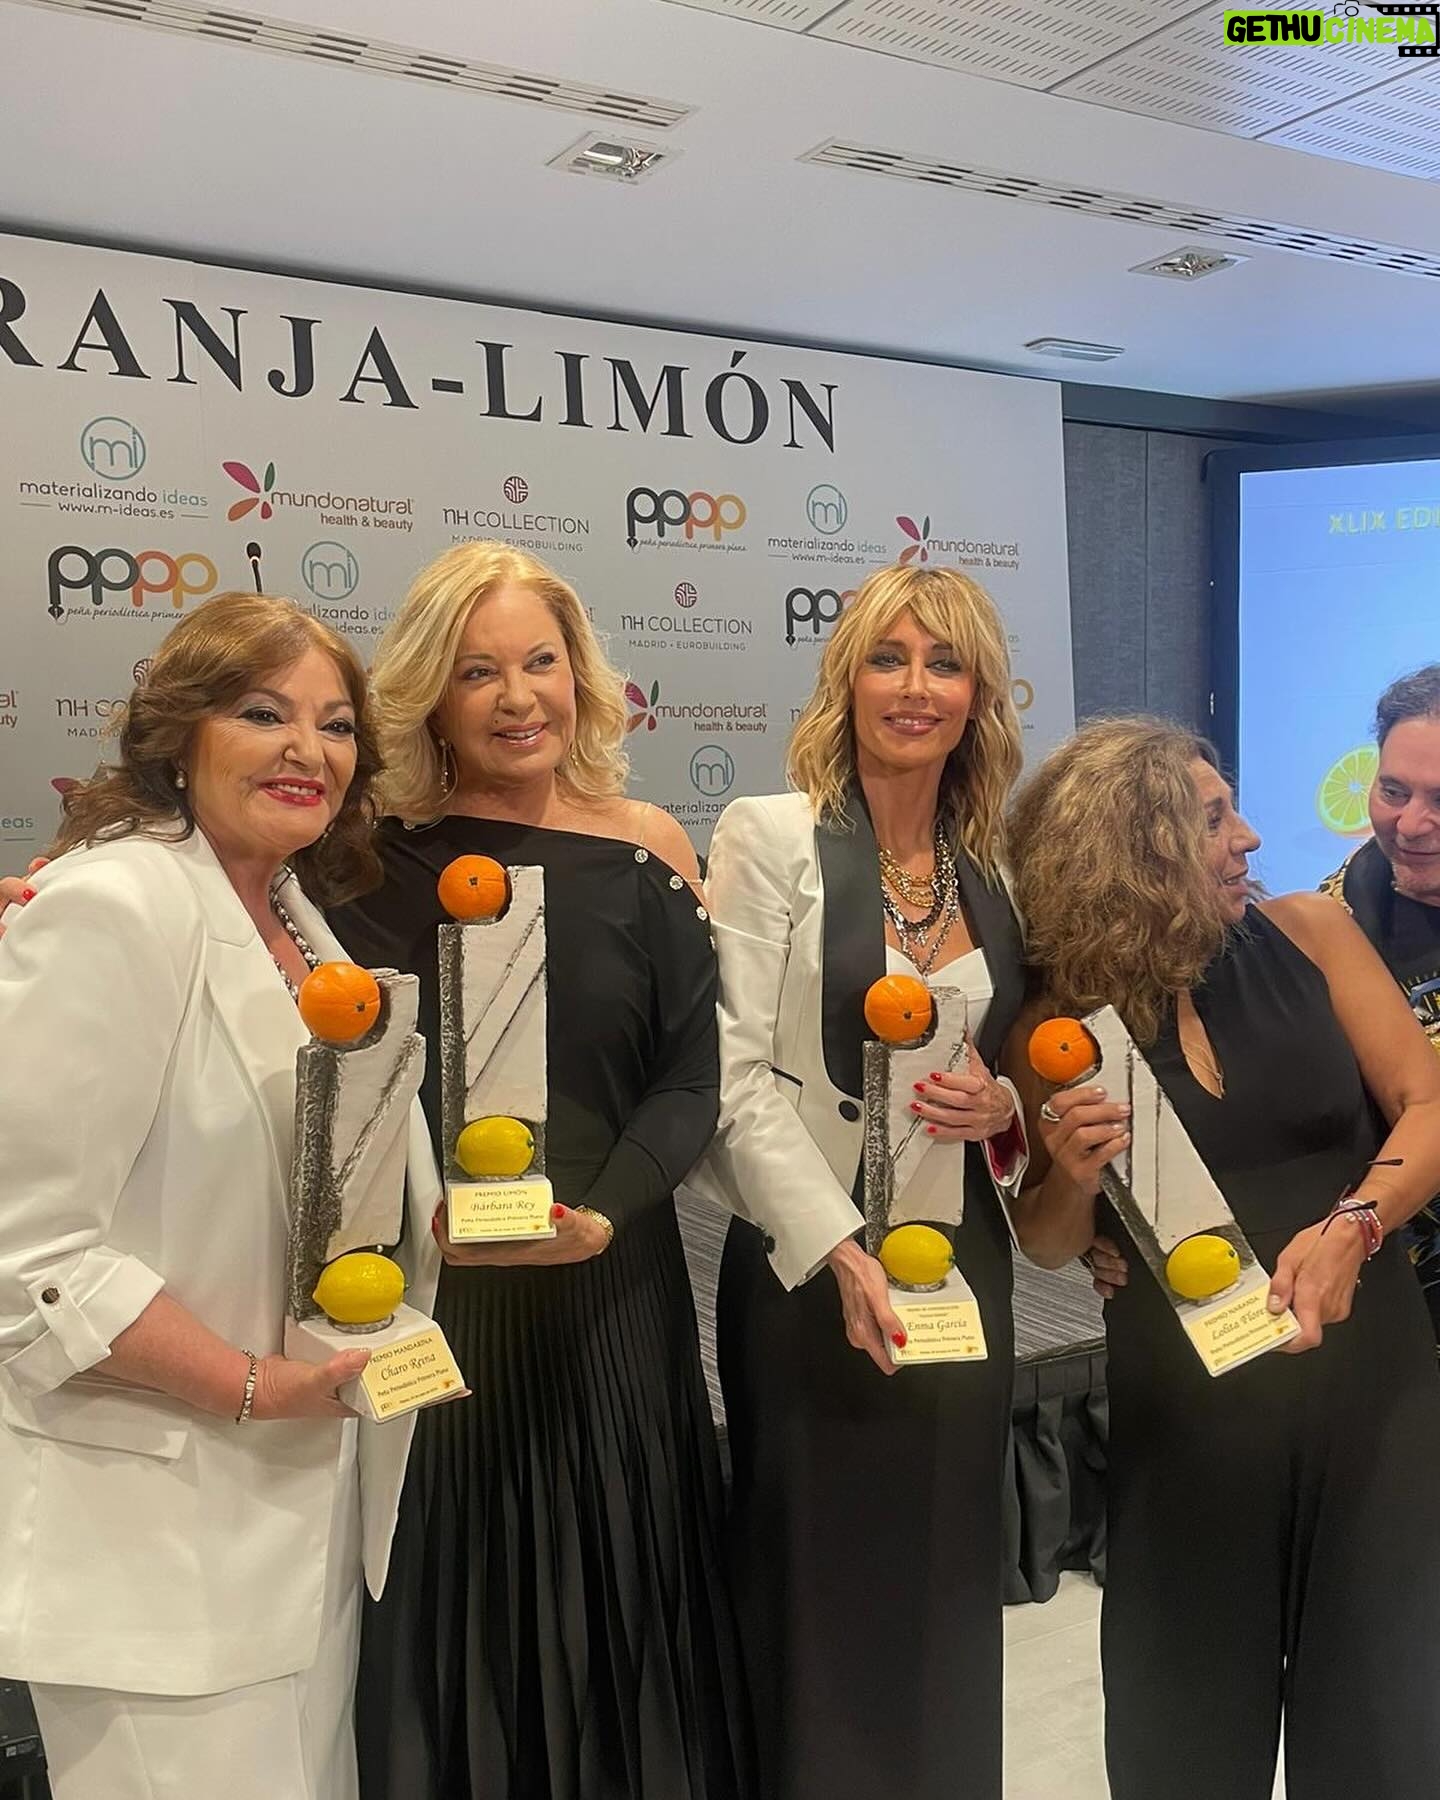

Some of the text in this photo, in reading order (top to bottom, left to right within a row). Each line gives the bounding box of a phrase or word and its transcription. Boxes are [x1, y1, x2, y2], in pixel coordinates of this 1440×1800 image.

[20, 481, 209, 507] materializando ideas
[58, 502, 175, 519] www.m-ideas.es
[271, 491, 413, 515] mundonatural
[320, 513, 414, 532] health & beauty
[473, 511, 590, 534] COLLECTION
[1329, 511, 1386, 535] XLIX
[767, 537, 887, 553] materializando ideas
[926, 539, 1019, 556] mundonatural
[791, 552, 866, 565] www.m-ideas.es
[993, 558, 1019, 570] beauty
[150, 611, 184, 622] primer
[647, 616, 752, 635] COLLECTION
[628, 640, 746, 651] MADRID EUROBUILDING
[655, 703, 767, 719] mundonatural
[694, 722, 768, 734] health & beauty
[516, 1200, 536, 1212] Rey
[1240, 1307, 1268, 1325] Flore
[906, 1321, 935, 1332] Emma
[394, 1337, 433, 1358] MANDARINA
[380, 1352, 437, 1381] Charo Reina
